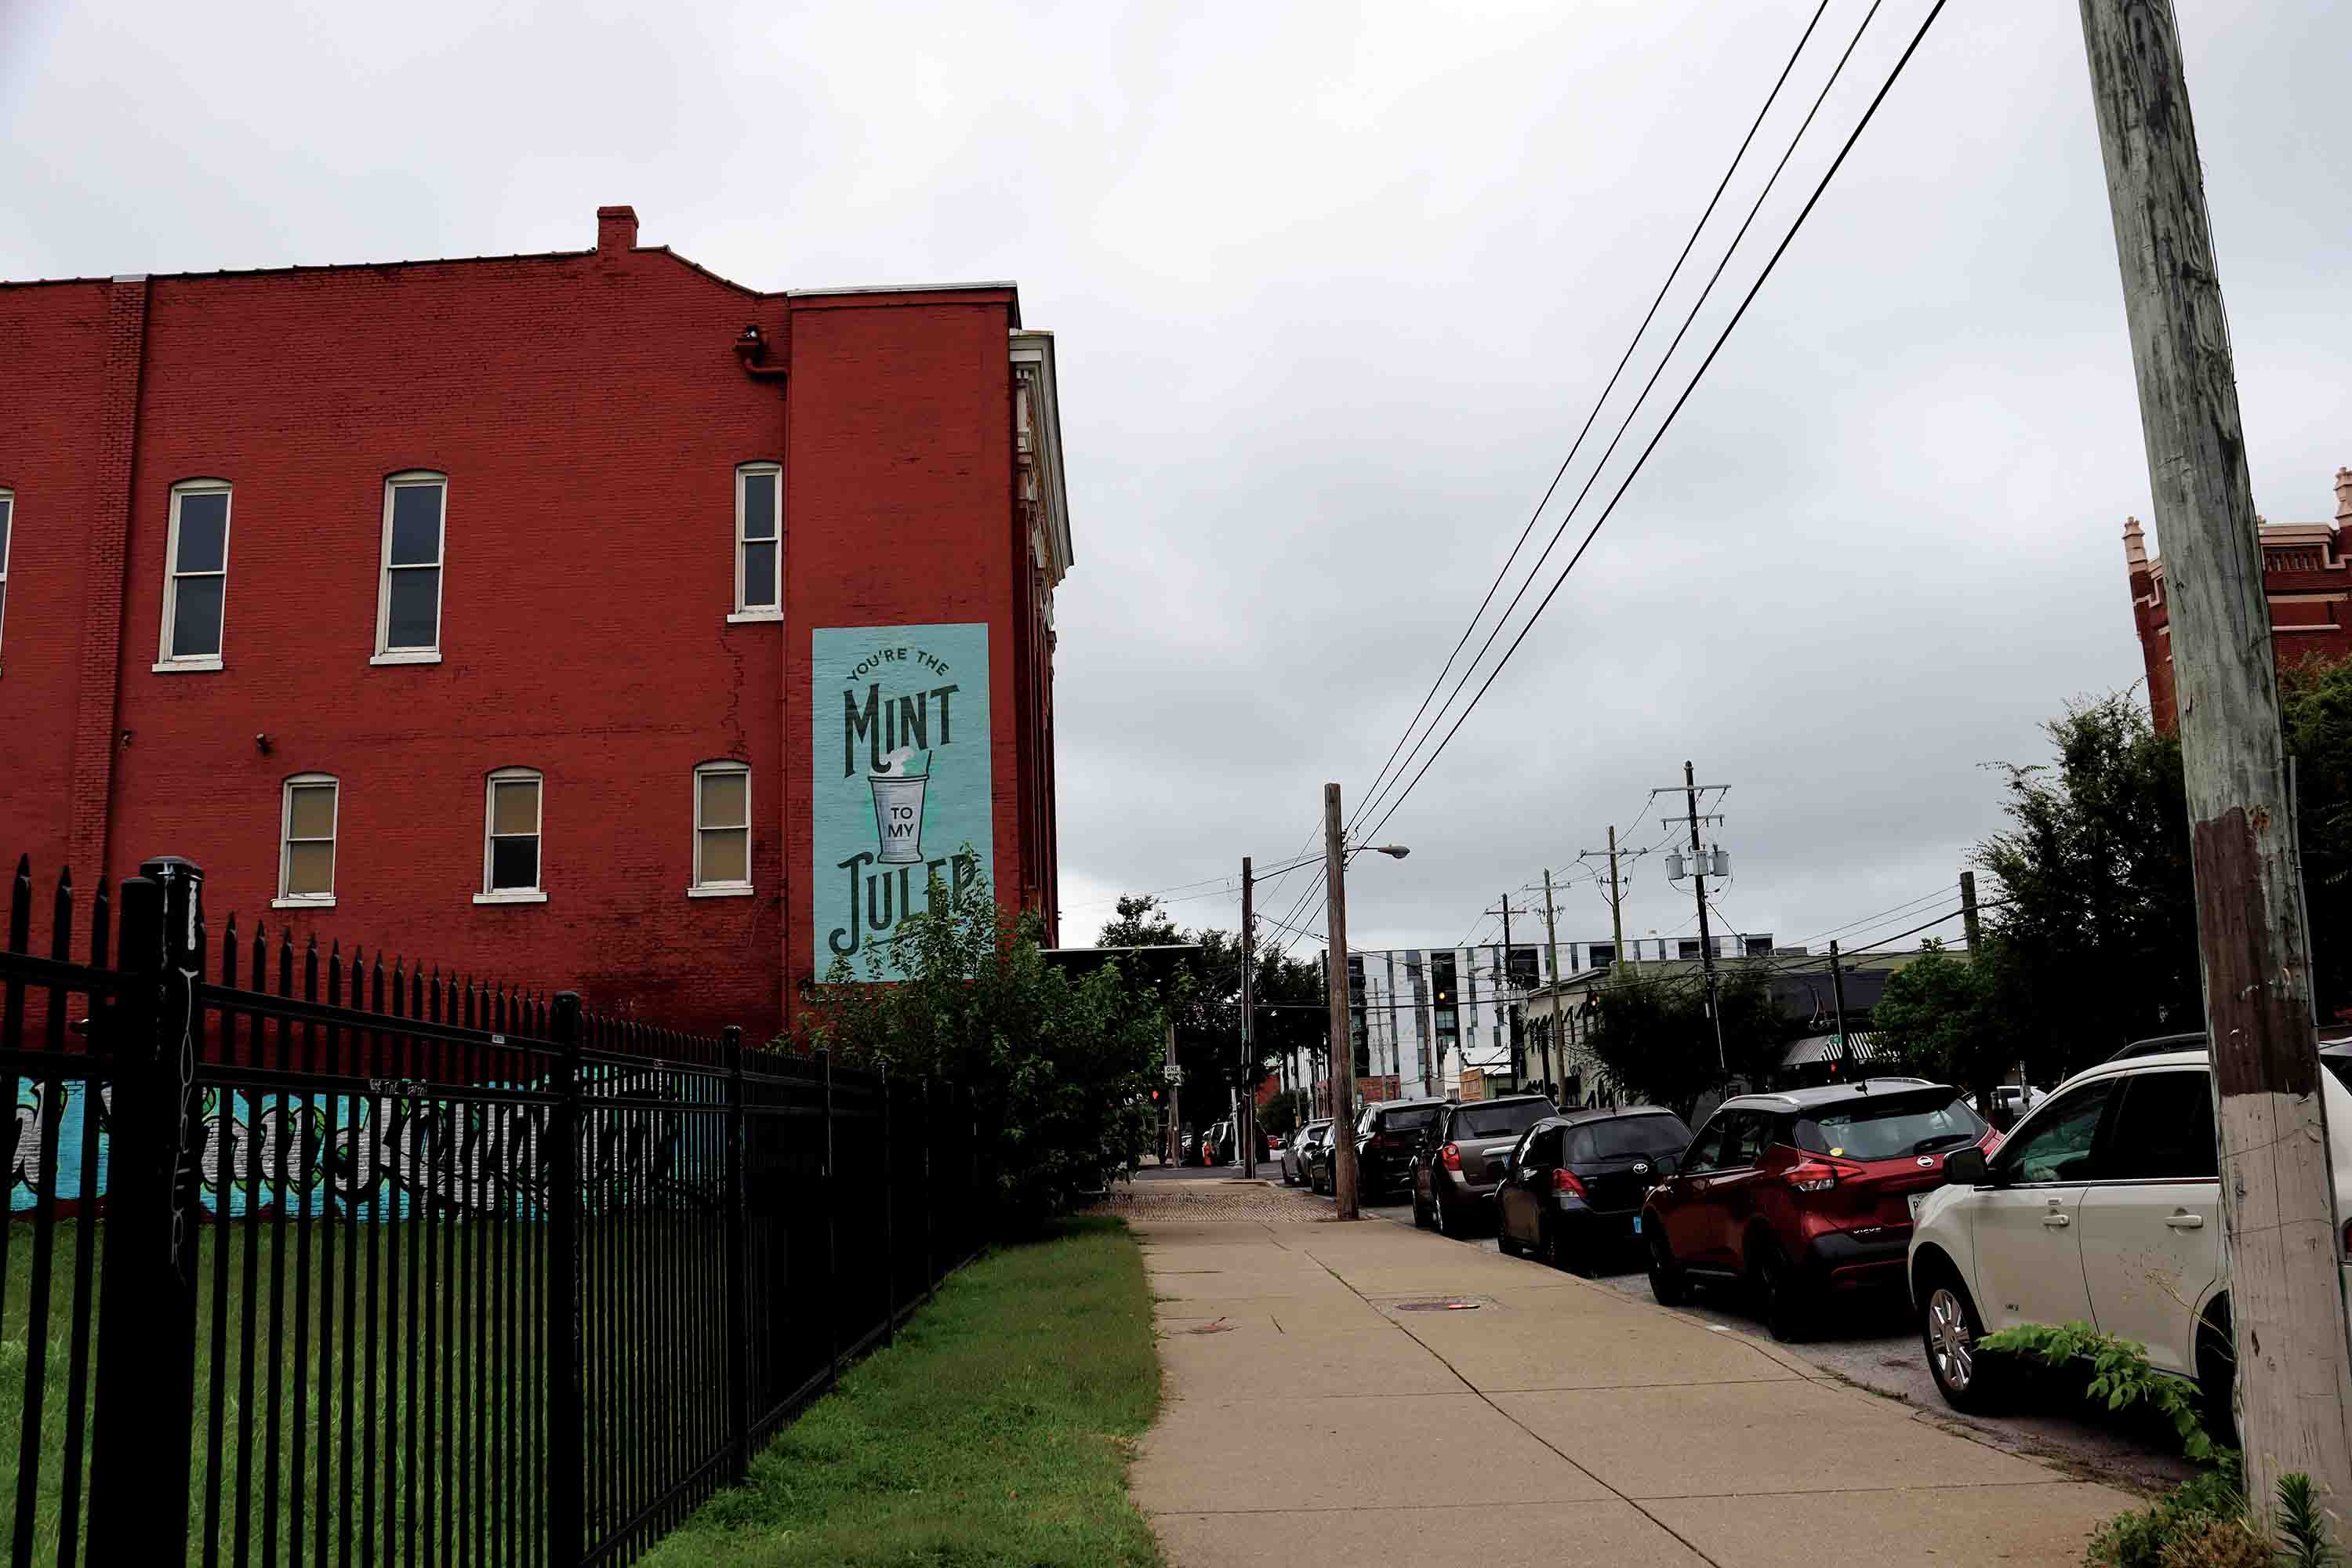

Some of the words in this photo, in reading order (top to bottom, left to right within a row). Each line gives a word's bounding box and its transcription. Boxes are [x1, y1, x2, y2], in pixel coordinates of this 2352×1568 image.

[846, 648, 907, 681] YOU'RE
[916, 650, 949, 677] THE
[843, 683, 960, 779] MINT
[890, 807, 913, 820] TO
[887, 823, 914, 837] MY
